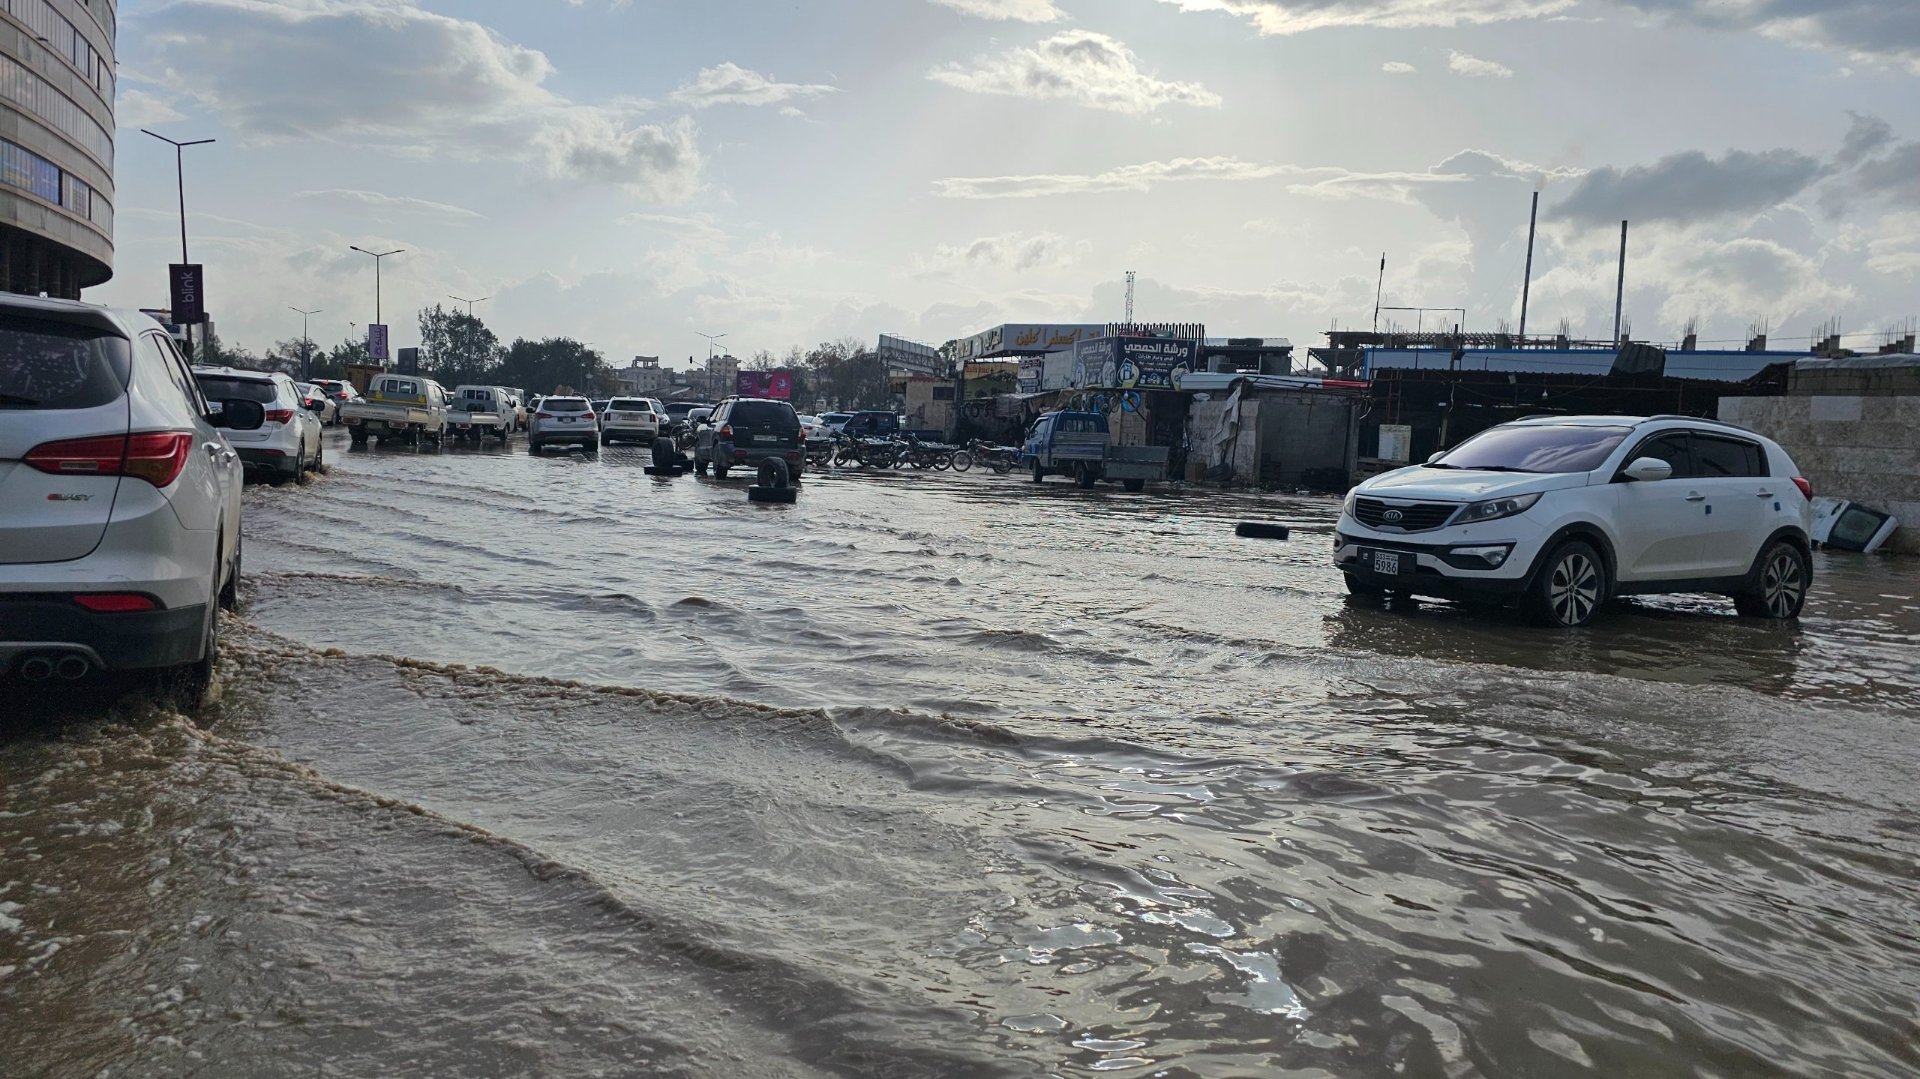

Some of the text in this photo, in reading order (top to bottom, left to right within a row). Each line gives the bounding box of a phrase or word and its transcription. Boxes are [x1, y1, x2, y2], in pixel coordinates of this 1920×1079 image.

[180, 271, 194, 303] blink
[1124, 342, 1188, 358] ورشة الحمصي
[1375, 560, 1397, 573] 5986
